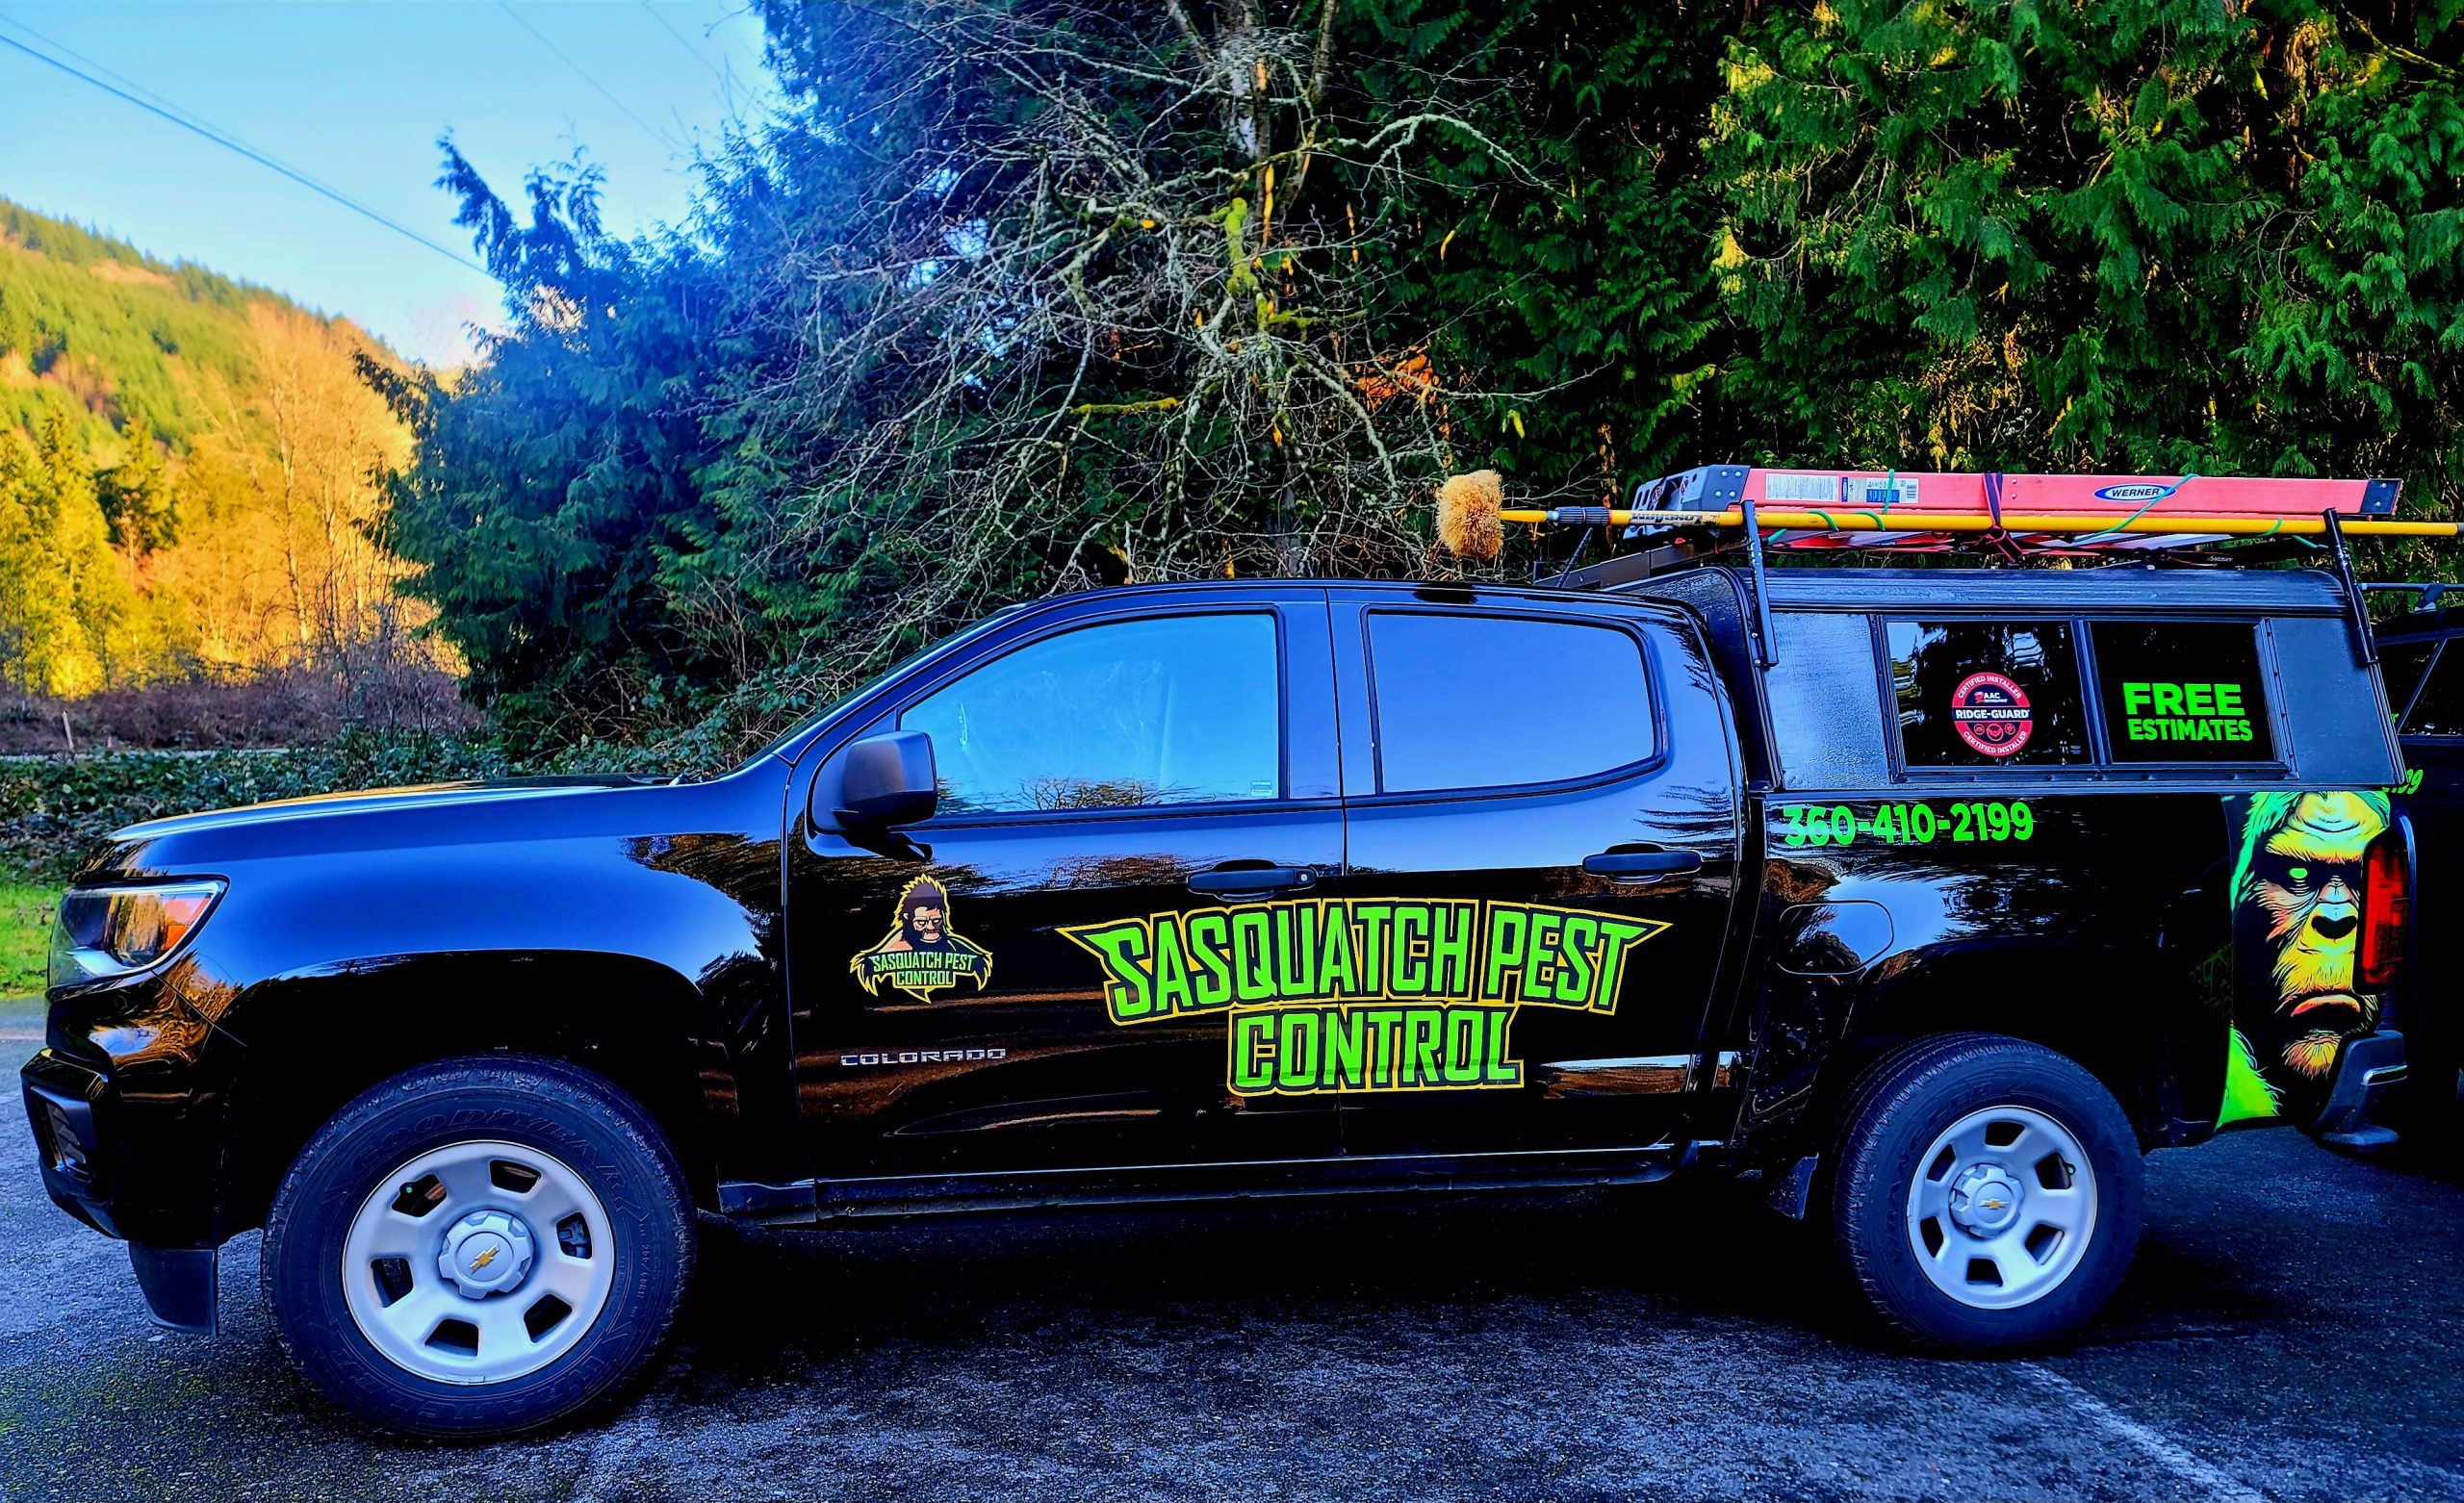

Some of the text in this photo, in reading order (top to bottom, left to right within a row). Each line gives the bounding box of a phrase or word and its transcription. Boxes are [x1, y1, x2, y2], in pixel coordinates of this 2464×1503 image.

[2111, 488, 2160, 497] WERNER
[1958, 675, 2021, 699] CERTIFIED INSTALLER
[2122, 682, 2246, 716] FREE
[1955, 709, 2029, 720] RIDGE-GUARD
[2127, 719, 2253, 741] ESTIMATES
[1964, 730, 2028, 754] CERTIFIED INSTALLER
[1783, 802, 2034, 847] 360-410-2199
[868, 952, 978, 972] SASQUATCH PEST
[1082, 905, 1649, 1018] SASQUATCH PEST
[896, 971, 953, 986] CONTROL
[840, 1048, 1007, 1066] COLORADO
[1235, 1008, 1520, 1088] CONTROL
